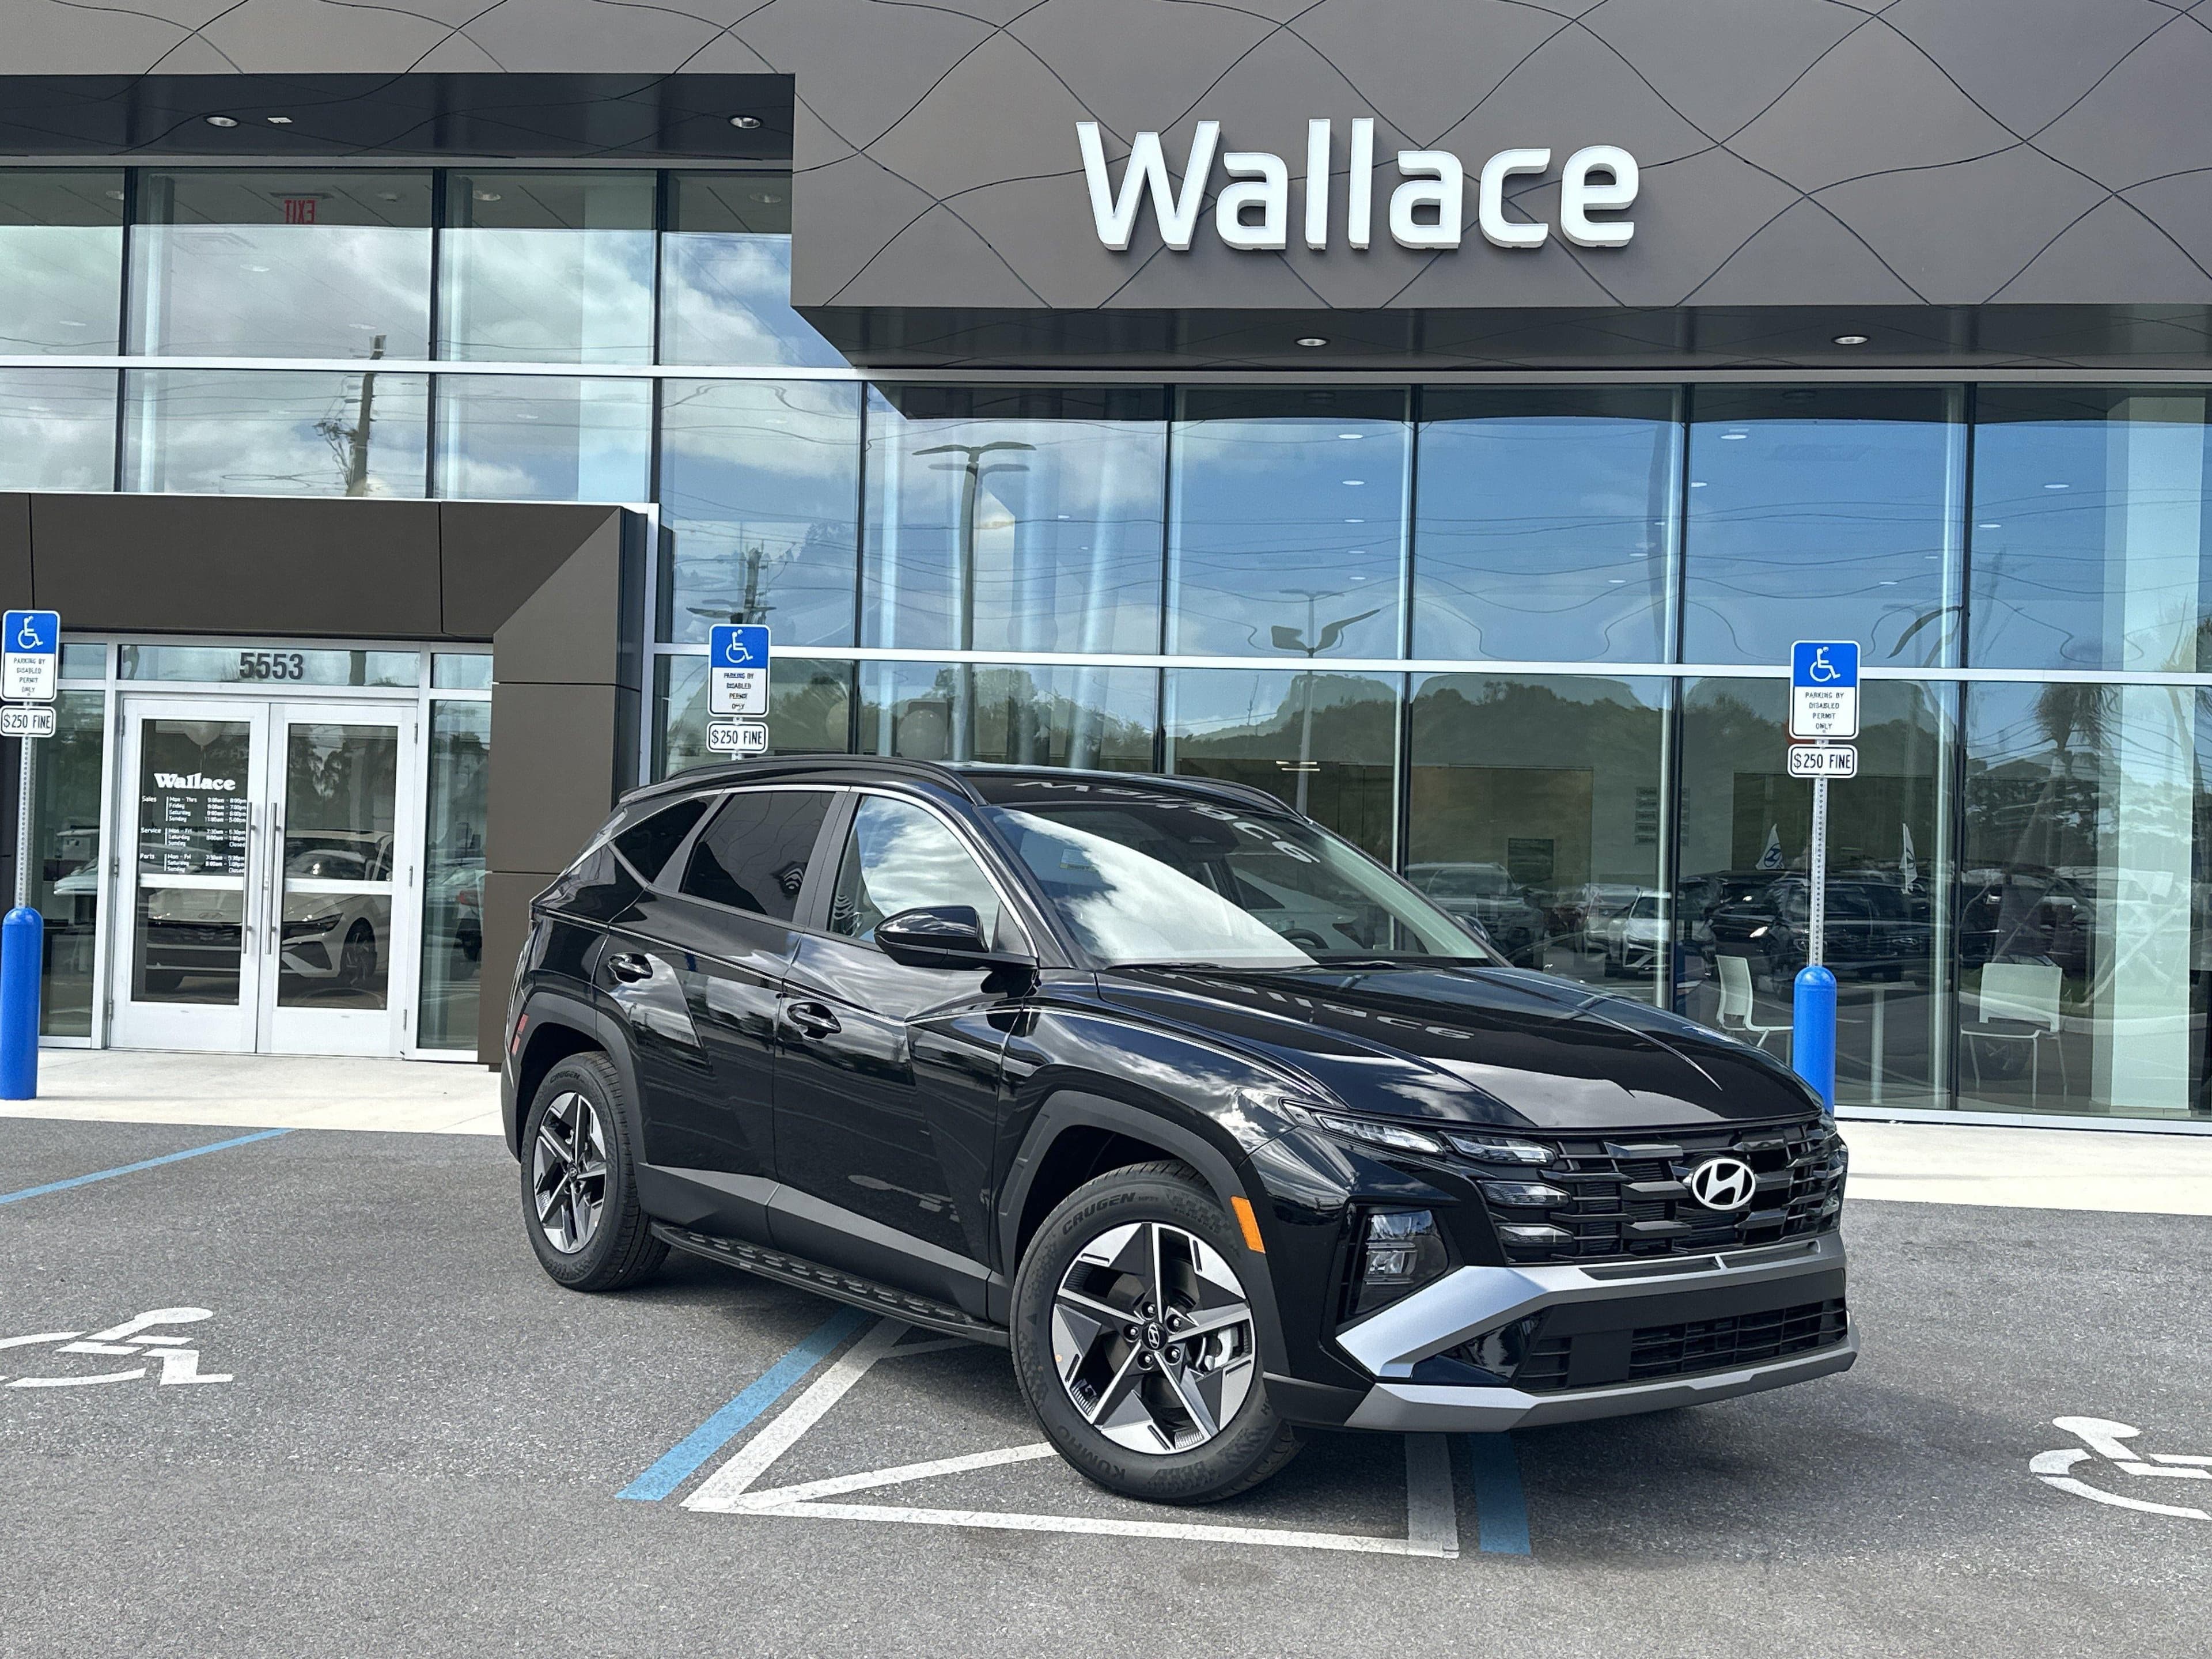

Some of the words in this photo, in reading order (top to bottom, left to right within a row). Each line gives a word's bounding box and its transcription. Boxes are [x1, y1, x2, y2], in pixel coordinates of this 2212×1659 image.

[1075, 117, 1639, 251] Wallace
[240, 652, 304, 680] 5553
[3, 713, 28, 729] $250
[33, 715, 51, 729] FINE
[711, 730, 738, 745] $250
[744, 730, 763, 745] FINE
[1793, 752, 1823, 770] $250
[1830, 754, 1851, 769] FINE
[154, 772, 236, 791] Wallace
[1062, 1192, 1136, 1235] CRUGEN
[1056, 1425, 1126, 1480] KUMHO
